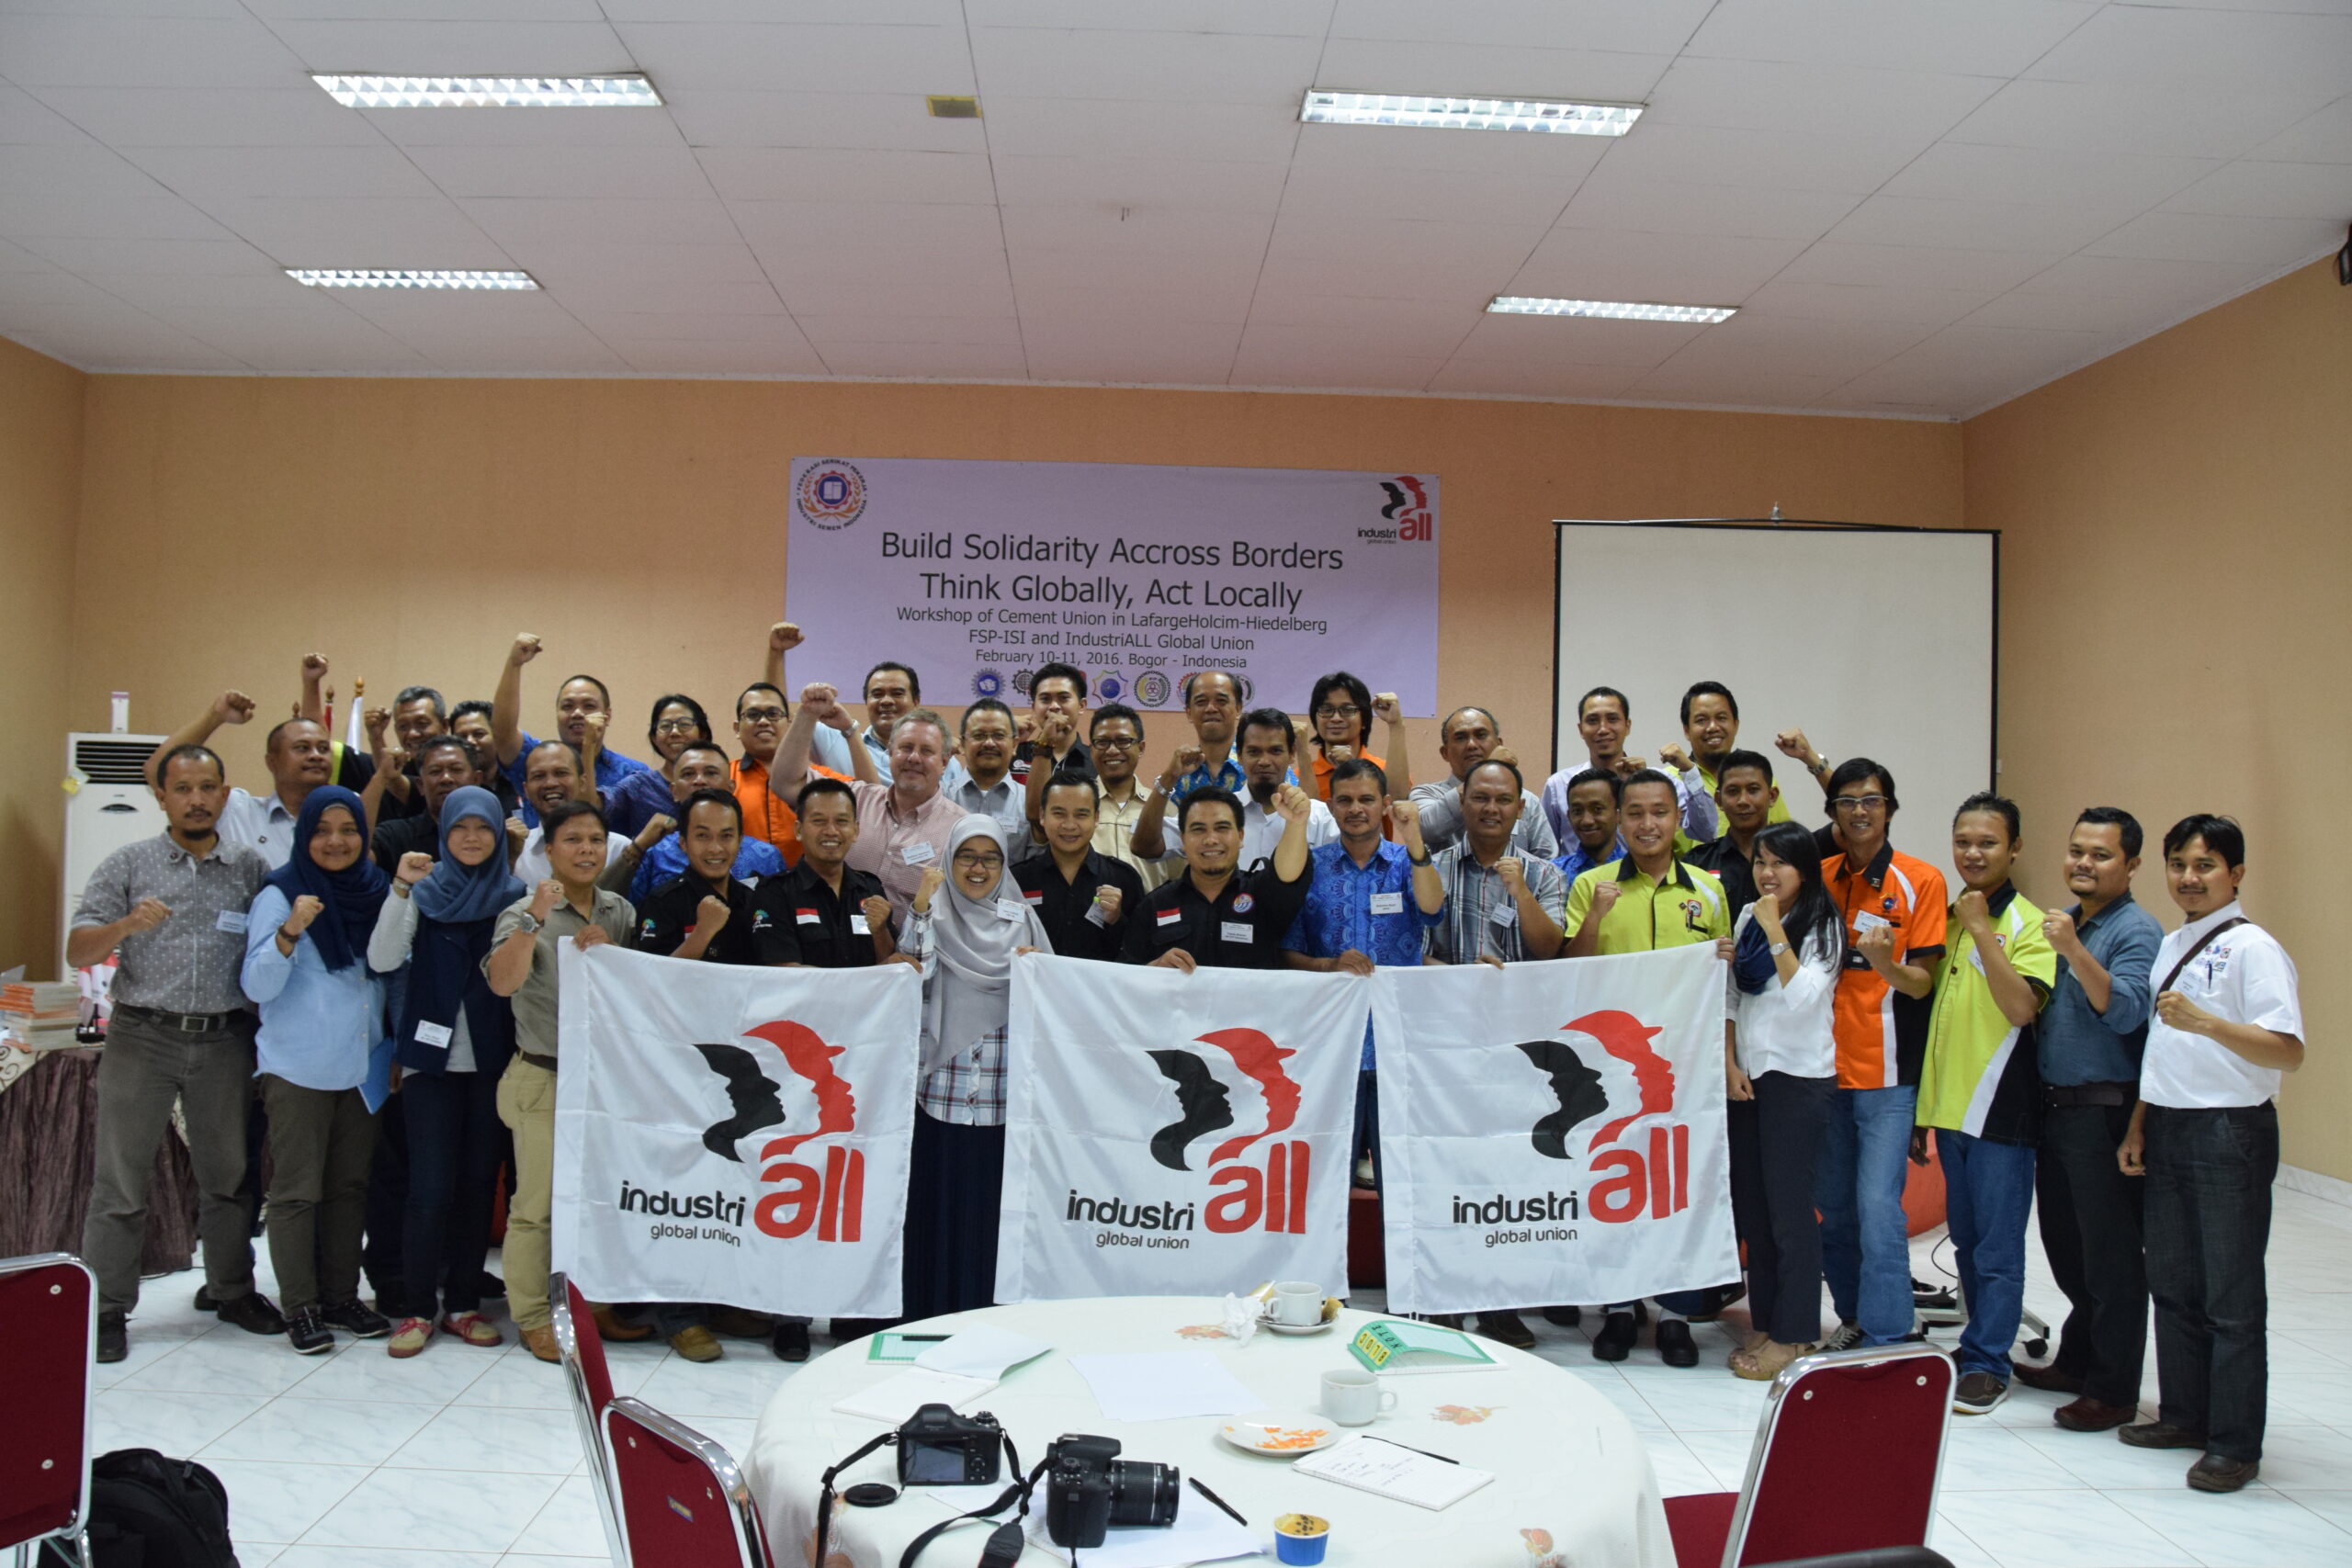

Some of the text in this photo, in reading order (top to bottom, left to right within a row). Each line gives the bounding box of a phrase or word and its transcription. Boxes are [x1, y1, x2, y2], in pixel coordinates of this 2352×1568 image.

[1357, 513, 1432, 541] industri all
[881, 531, 1344, 570] Build Solidarity Accross Borders
[919, 572, 1303, 615] Think Globally, Act Locally
[896, 606, 1328, 635] Workshop of Cement Union in LafargeHolcim-Hiedelberg
[968, 629, 1255, 650] FSP-ISI and IndustriALL Global Union
[975, 649, 1035, 665] February
[1039, 650, 1082, 667] 10-11,
[1086, 651, 1123, 665] 2016.
[1128, 653, 1169, 669] Bogor
[1182, 655, 1248, 668] Indonesia
[1066, 1139, 1311, 1235] industri all
[1453, 1123, 1690, 1224] industri all
[618, 1145, 865, 1243] industri all
[650, 1223, 741, 1247] global union
[1095, 1230, 1190, 1249] global union
[1485, 1227, 1578, 1248] global union
[1371, 1325, 1403, 1349] NOTE
